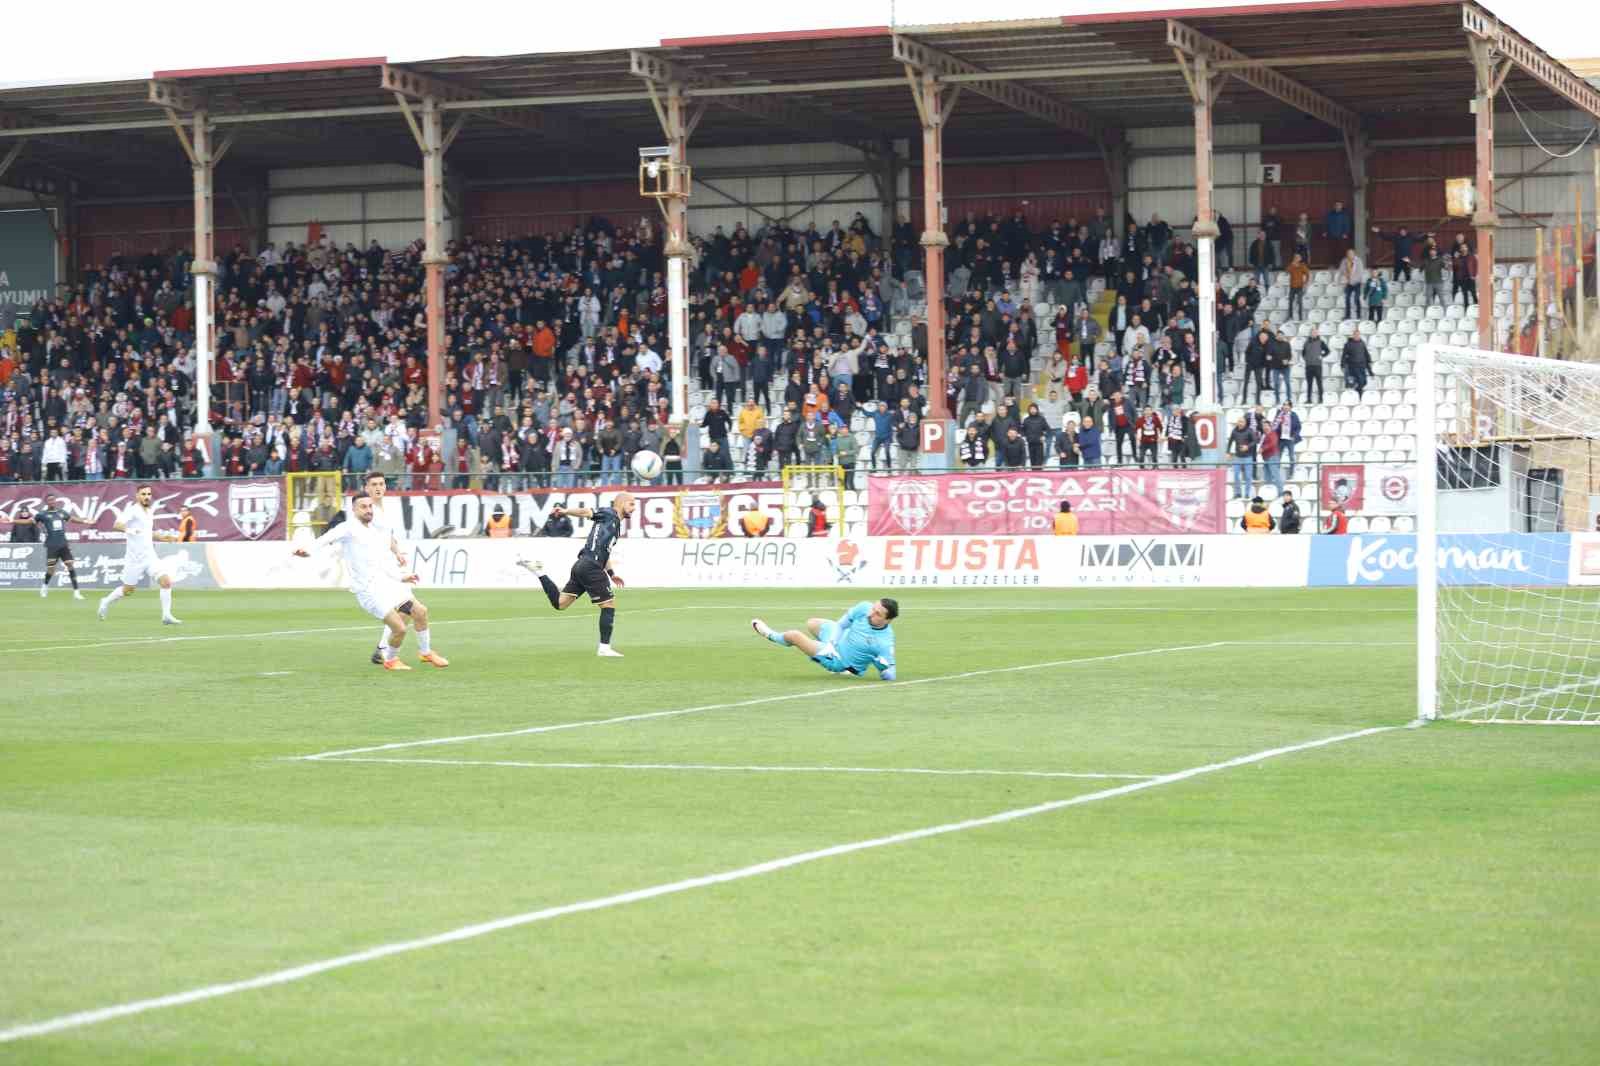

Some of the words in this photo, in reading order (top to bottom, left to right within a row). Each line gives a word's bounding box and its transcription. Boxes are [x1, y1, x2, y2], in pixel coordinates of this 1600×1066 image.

[923, 423, 943, 451] P
[728, 494, 784, 537] 65
[967, 498, 1126, 518] ÇOCUKARI
[681, 542, 798, 566] HEP-KAR
[883, 539, 1040, 571] ETUSTA
[1347, 536, 1530, 585] Kocman
